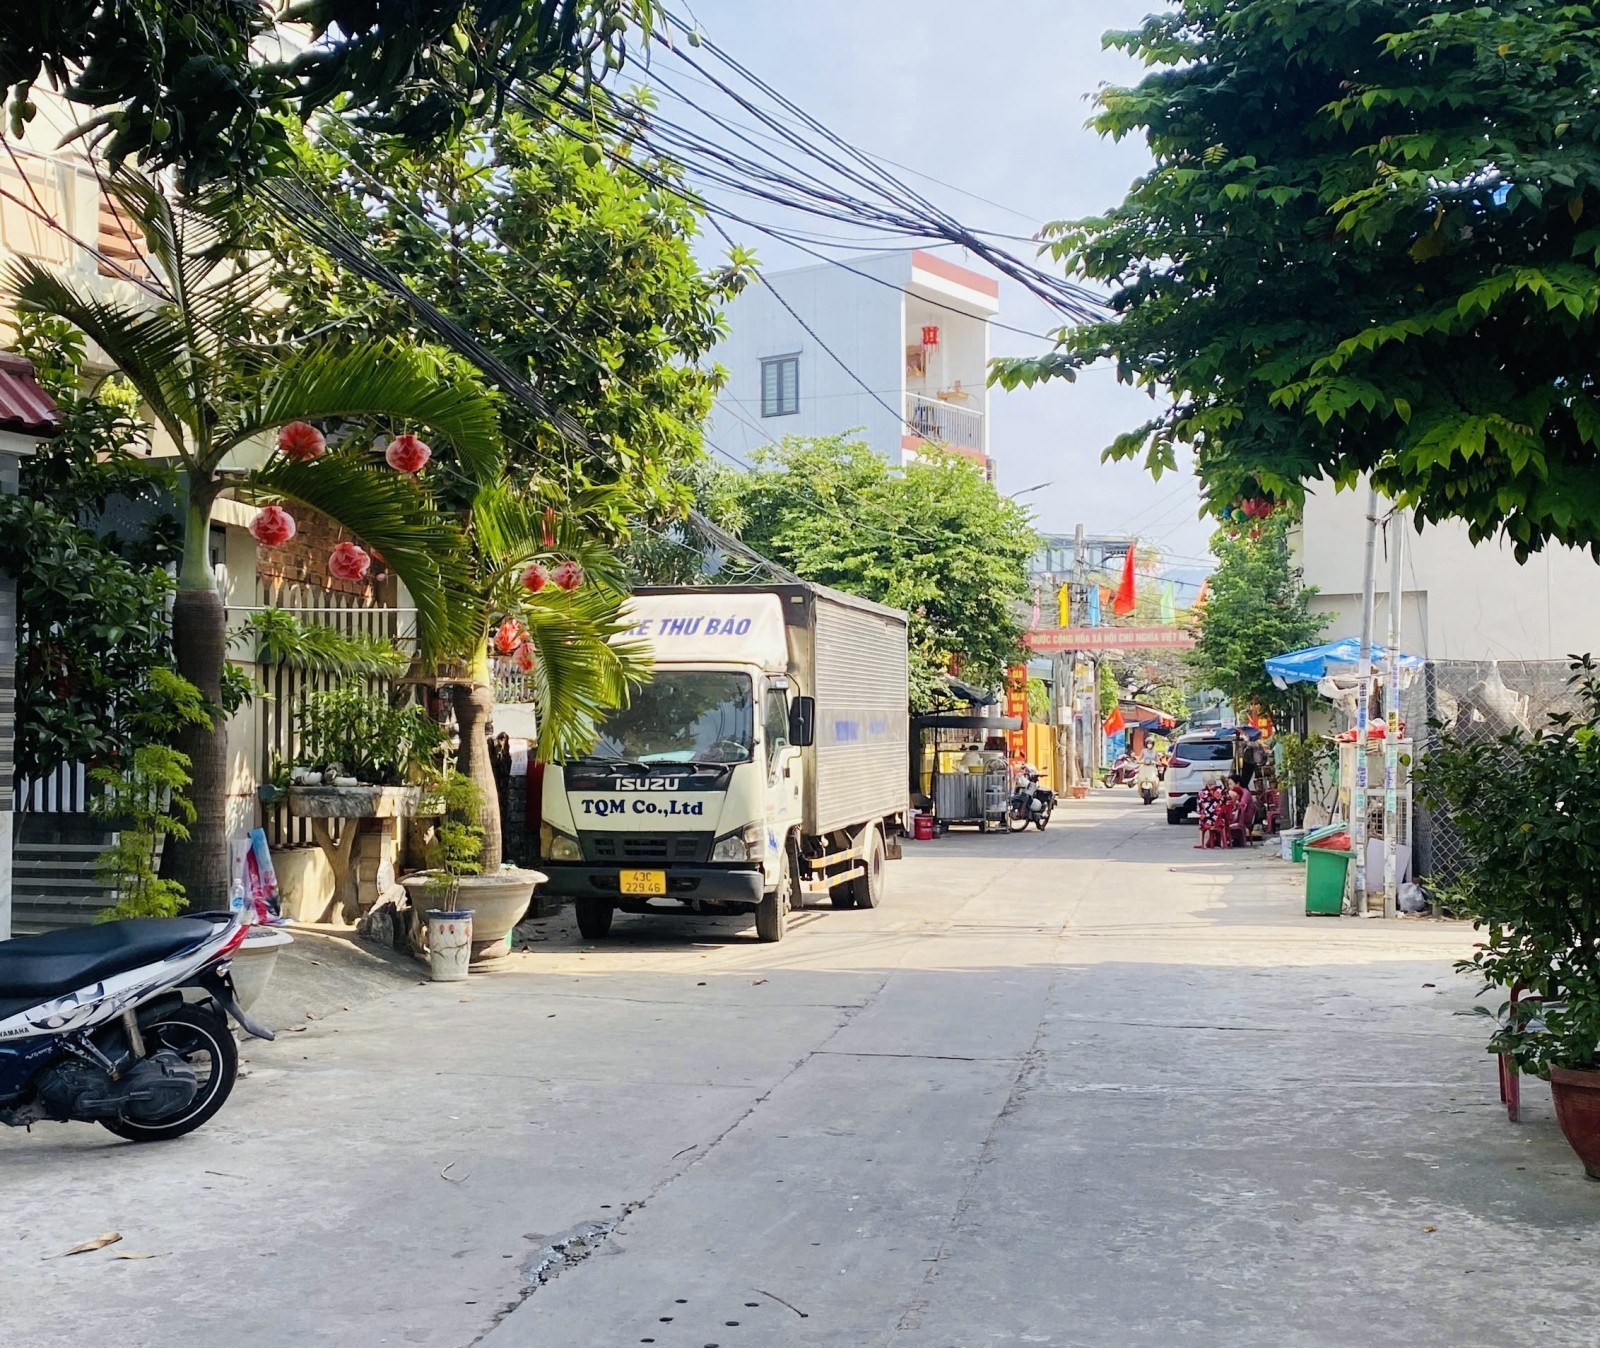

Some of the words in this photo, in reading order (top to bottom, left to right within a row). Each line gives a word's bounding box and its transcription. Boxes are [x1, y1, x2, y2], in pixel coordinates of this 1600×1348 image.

[658, 615, 704, 636] THƯ
[704, 614, 751, 636] BÁO
[615, 778, 679, 791] ISUZU
[581, 799, 626, 816] TQM
[632, 800, 703, 817] Co.,Ltd
[633, 872, 652, 882] 43C
[626, 883, 661, 893] 229.46
